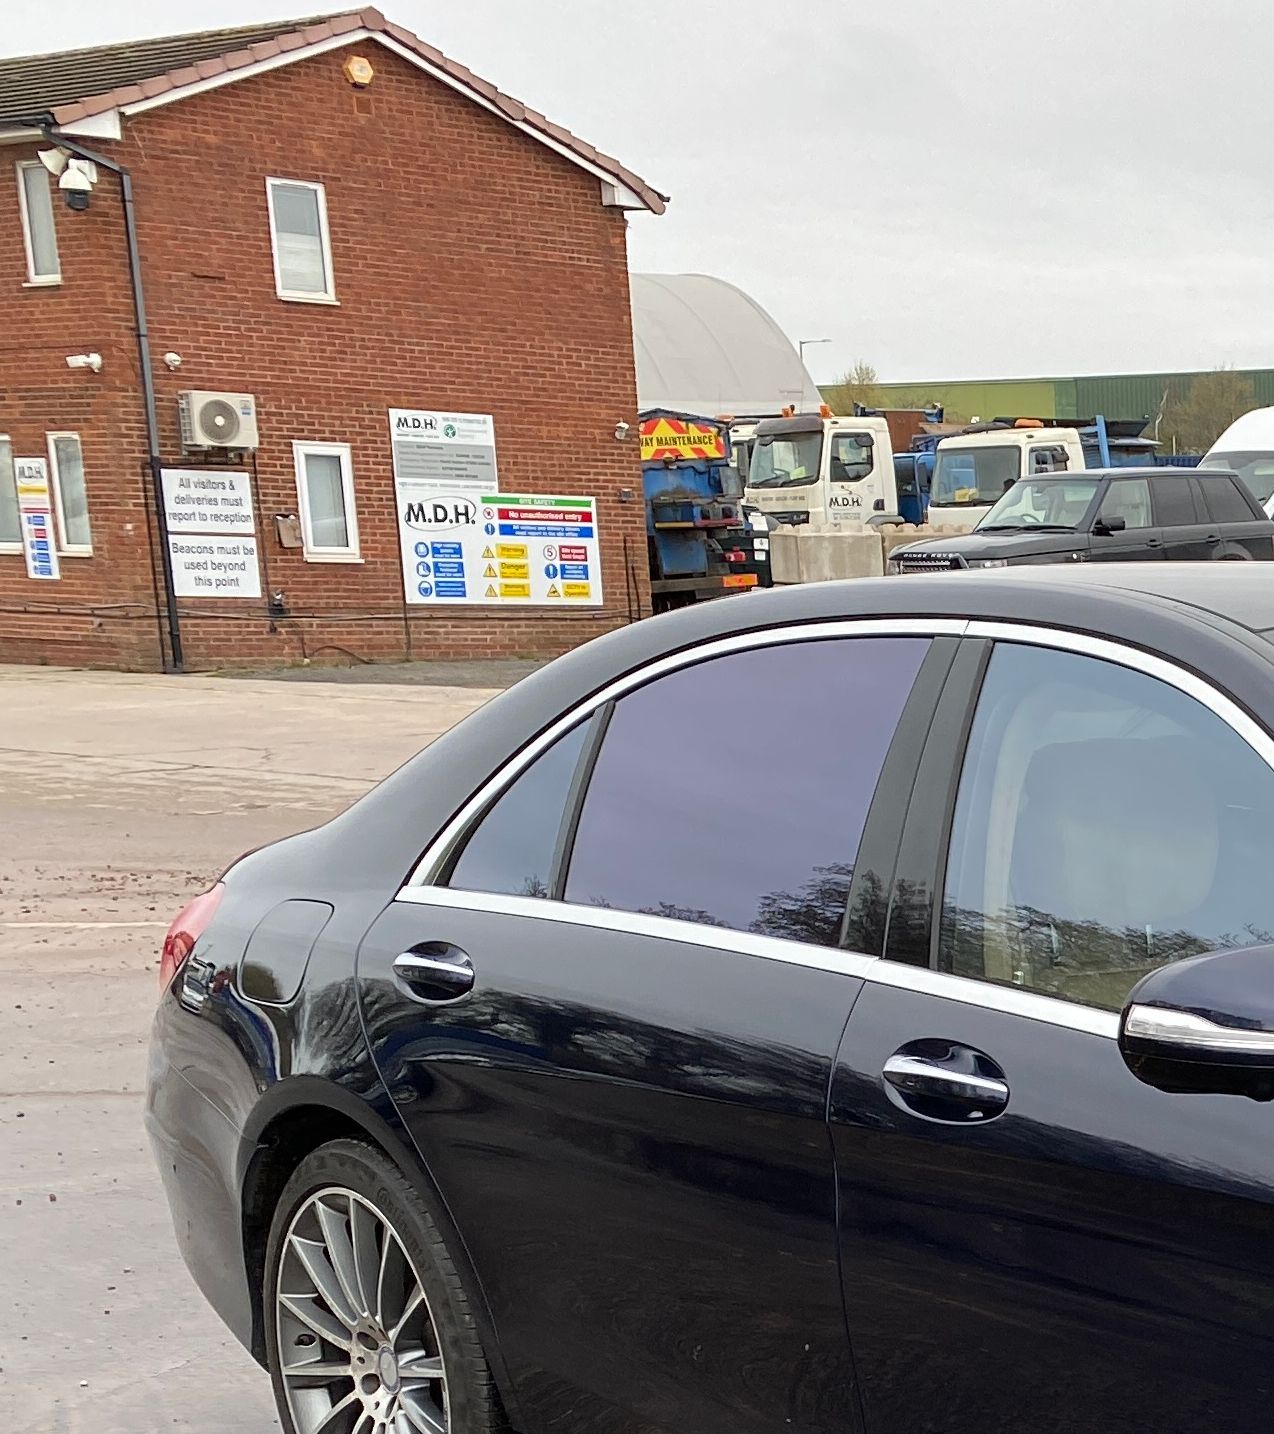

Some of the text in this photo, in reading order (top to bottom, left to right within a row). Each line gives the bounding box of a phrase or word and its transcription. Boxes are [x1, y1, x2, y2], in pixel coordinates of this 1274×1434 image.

[656, 435, 713, 446] MAINTENANCE
[178, 478, 236, 491] All visitors &
[174, 494, 244, 507] deliveries must
[168, 512, 252, 525] report to reception
[407, 502, 476, 525] M.D.H.
[171, 542, 255, 556] Beacons must be
[184, 560, 246, 573] used beyond
[194, 576, 240, 589] this point
